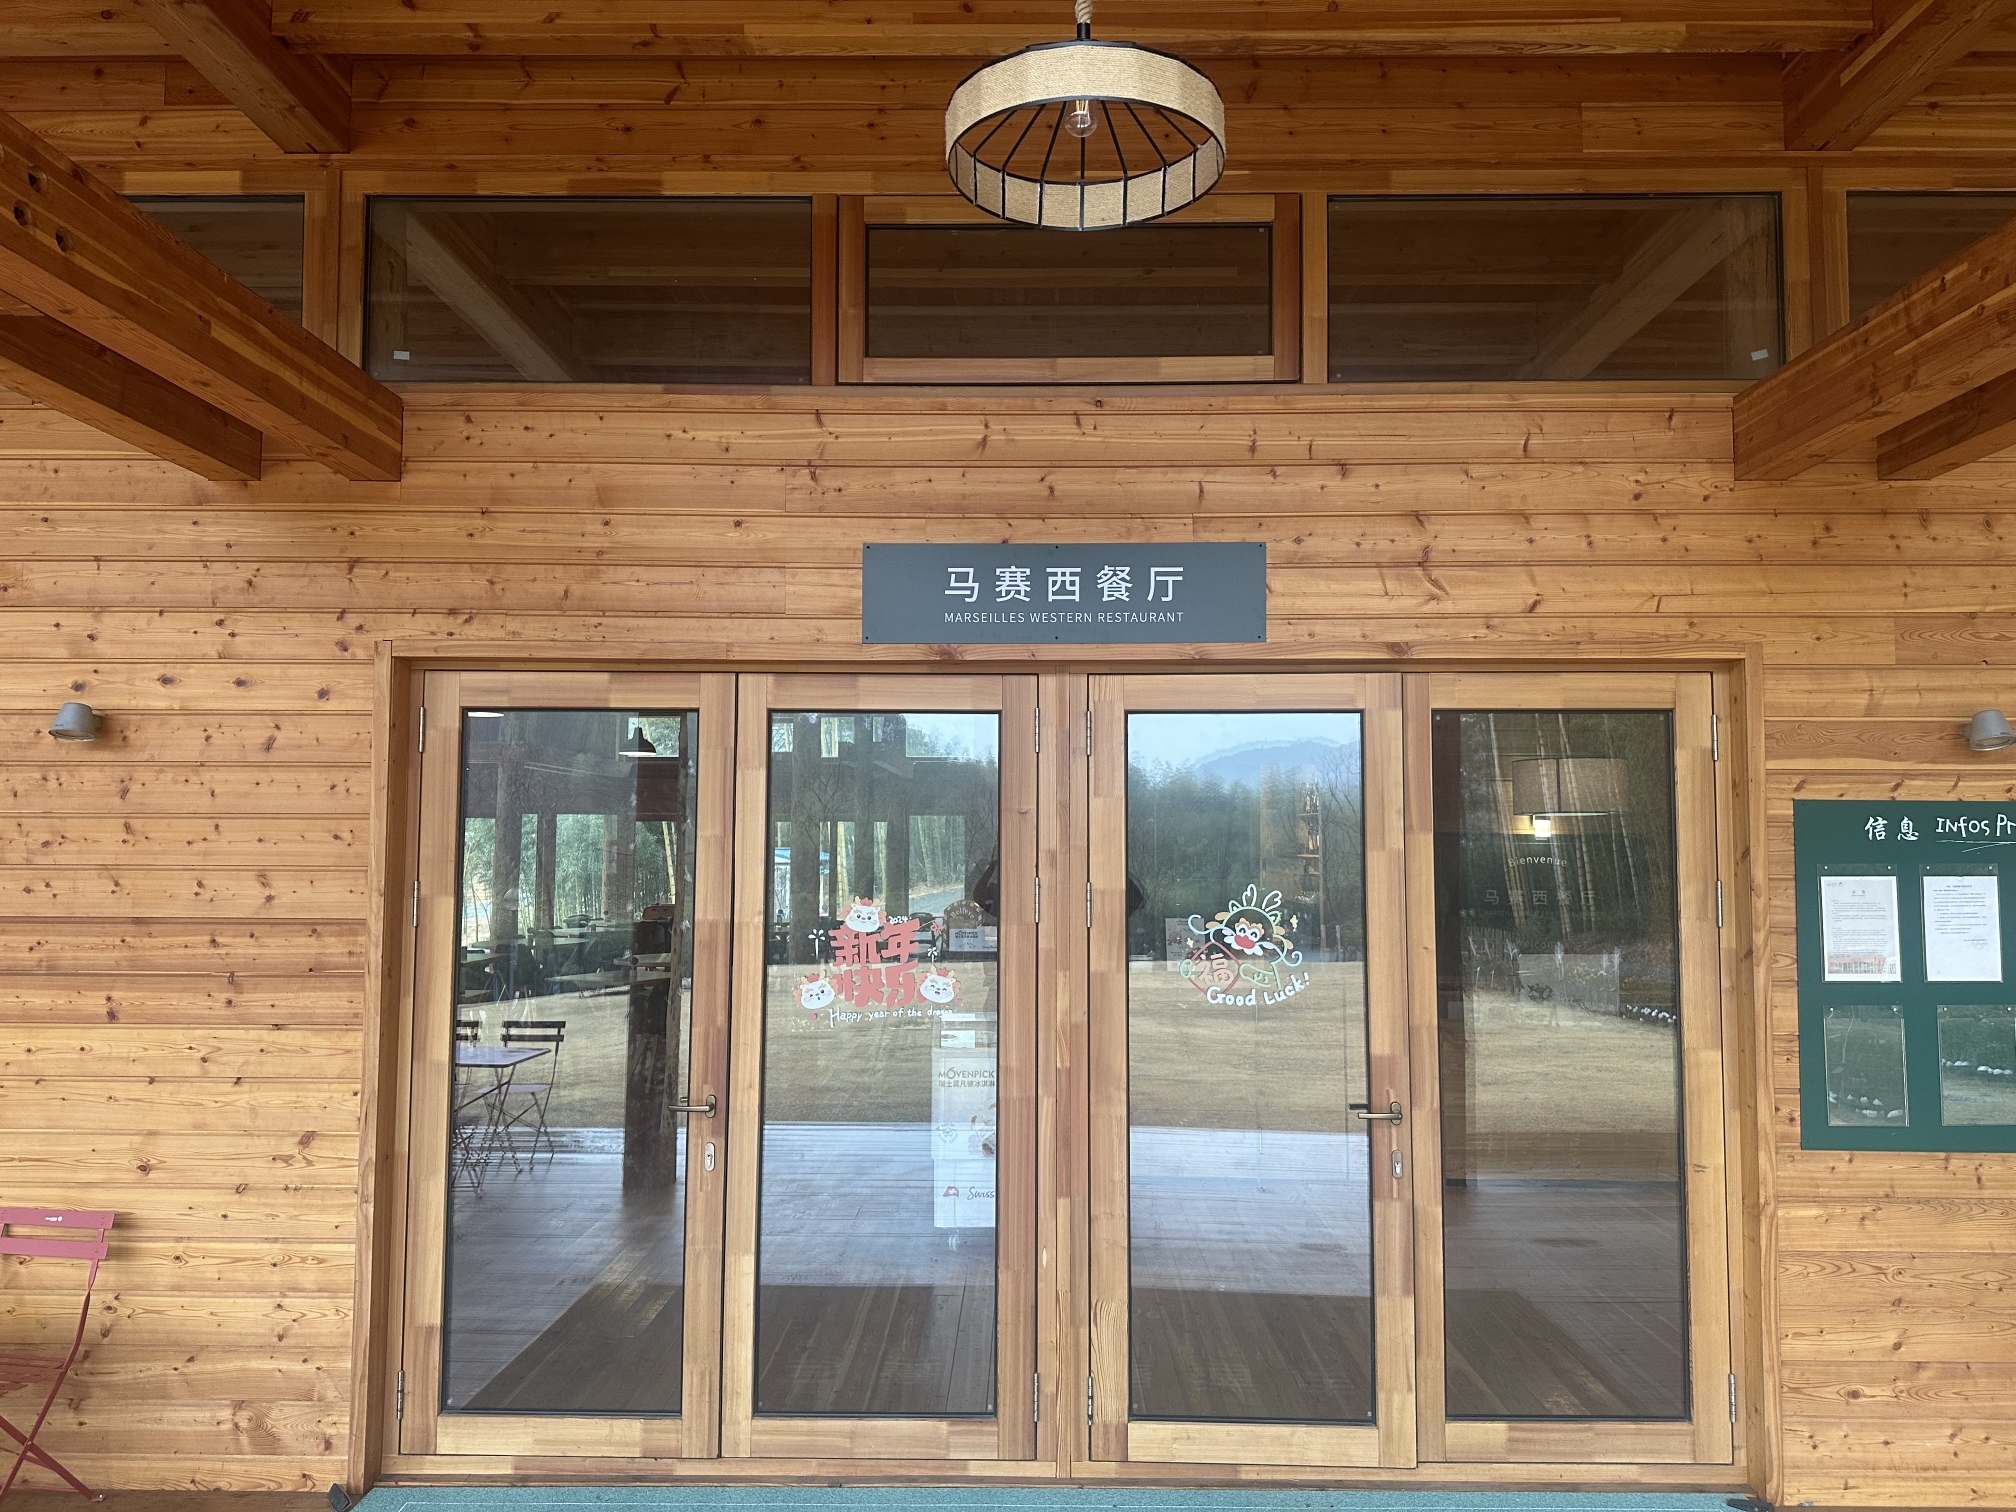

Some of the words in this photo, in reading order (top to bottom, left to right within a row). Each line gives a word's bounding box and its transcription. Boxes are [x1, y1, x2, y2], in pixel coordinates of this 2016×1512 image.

[944, 565, 1184, 603] 马赛西餐厅
[944, 612, 1025, 623] MARSEILLES
[1029, 612, 1092, 623] WESTERN
[1097, 612, 1184, 623] RESTAURANT
[1864, 815, 1919, 841] 信息
[1508, 855, 1567, 867] Bienvenue
[888, 915, 908, 925] 2024
[828, 917, 920, 968] 新年
[832, 959, 926, 1009] 快乐
[1196, 952, 1234, 986] 福
[1206, 985, 1257, 1006] Good
[1263, 971, 1310, 1006] Luck!
[829, 1007, 862, 1028] Happy
[868, 1010, 889, 1021] year
[893, 1007, 904, 1018] of
[907, 1006, 922, 1017] the
